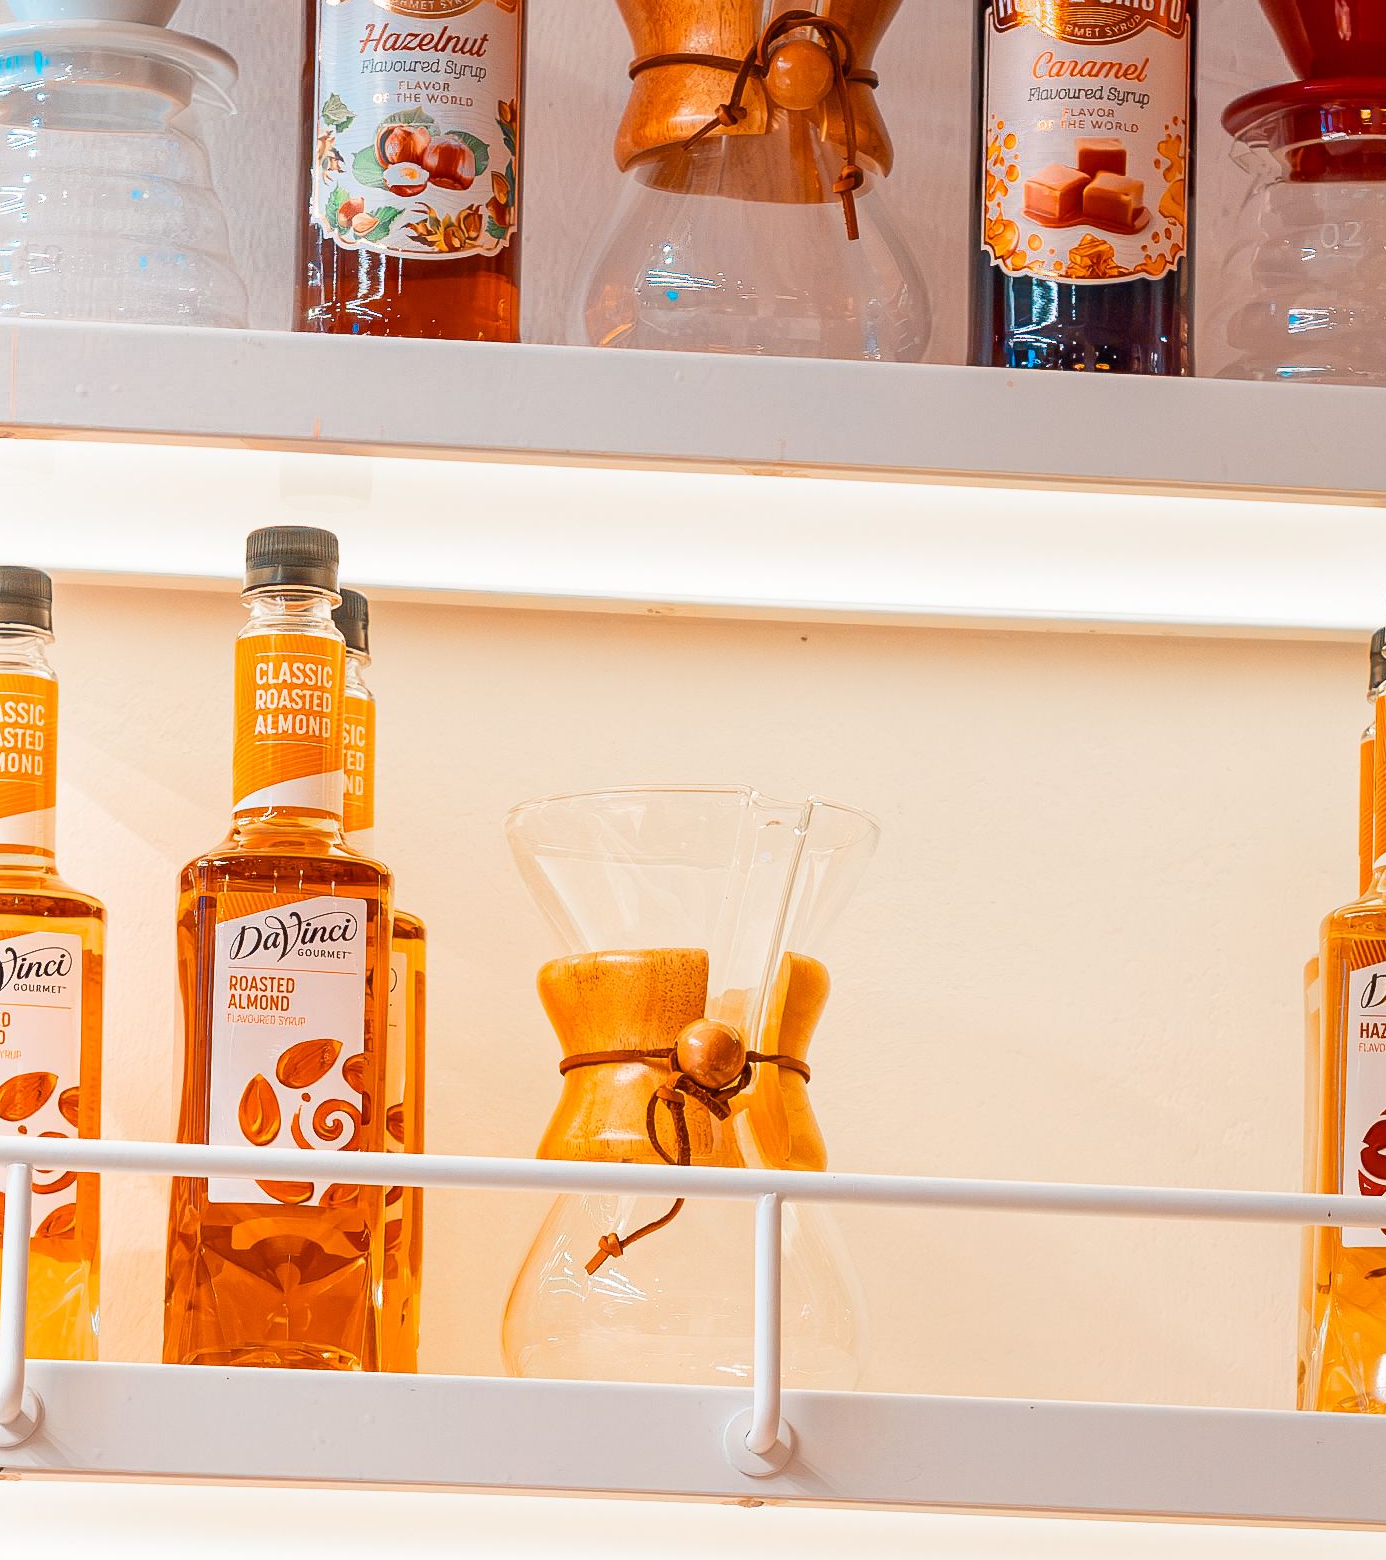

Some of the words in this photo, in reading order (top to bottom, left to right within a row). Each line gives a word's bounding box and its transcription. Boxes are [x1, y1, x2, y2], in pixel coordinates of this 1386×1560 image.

[1106, 14, 1142, 36] SYRUP
[359, 22, 490, 58] Hazelnut
[360, 58, 440, 75] Flavoured
[444, 60, 487, 83] Syrup
[1031, 50, 1150, 83] Caramel
[396, 92, 422, 103] THE
[398, 80, 451, 92] FLAVOR
[1027, 86, 1104, 103] Flavoured
[1106, 87, 1150, 110] Syrup
[1062, 107, 1115, 118] FLAVOR
[1061, 119, 1086, 130] THE
[1090, 120, 1140, 133] WORLD
[254, 661, 333, 689] CLASSIC
[254, 688, 332, 713] ROASTED
[254, 713, 332, 739] ALMOND
[229, 911, 358, 963] DaVinci
[228, 975, 296, 995] ROASTED
[227, 994, 291, 1012] ALMOND
[226, 1013, 276, 1026] FLAVOURED
[278, 1015, 307, 1027] SYRUP
